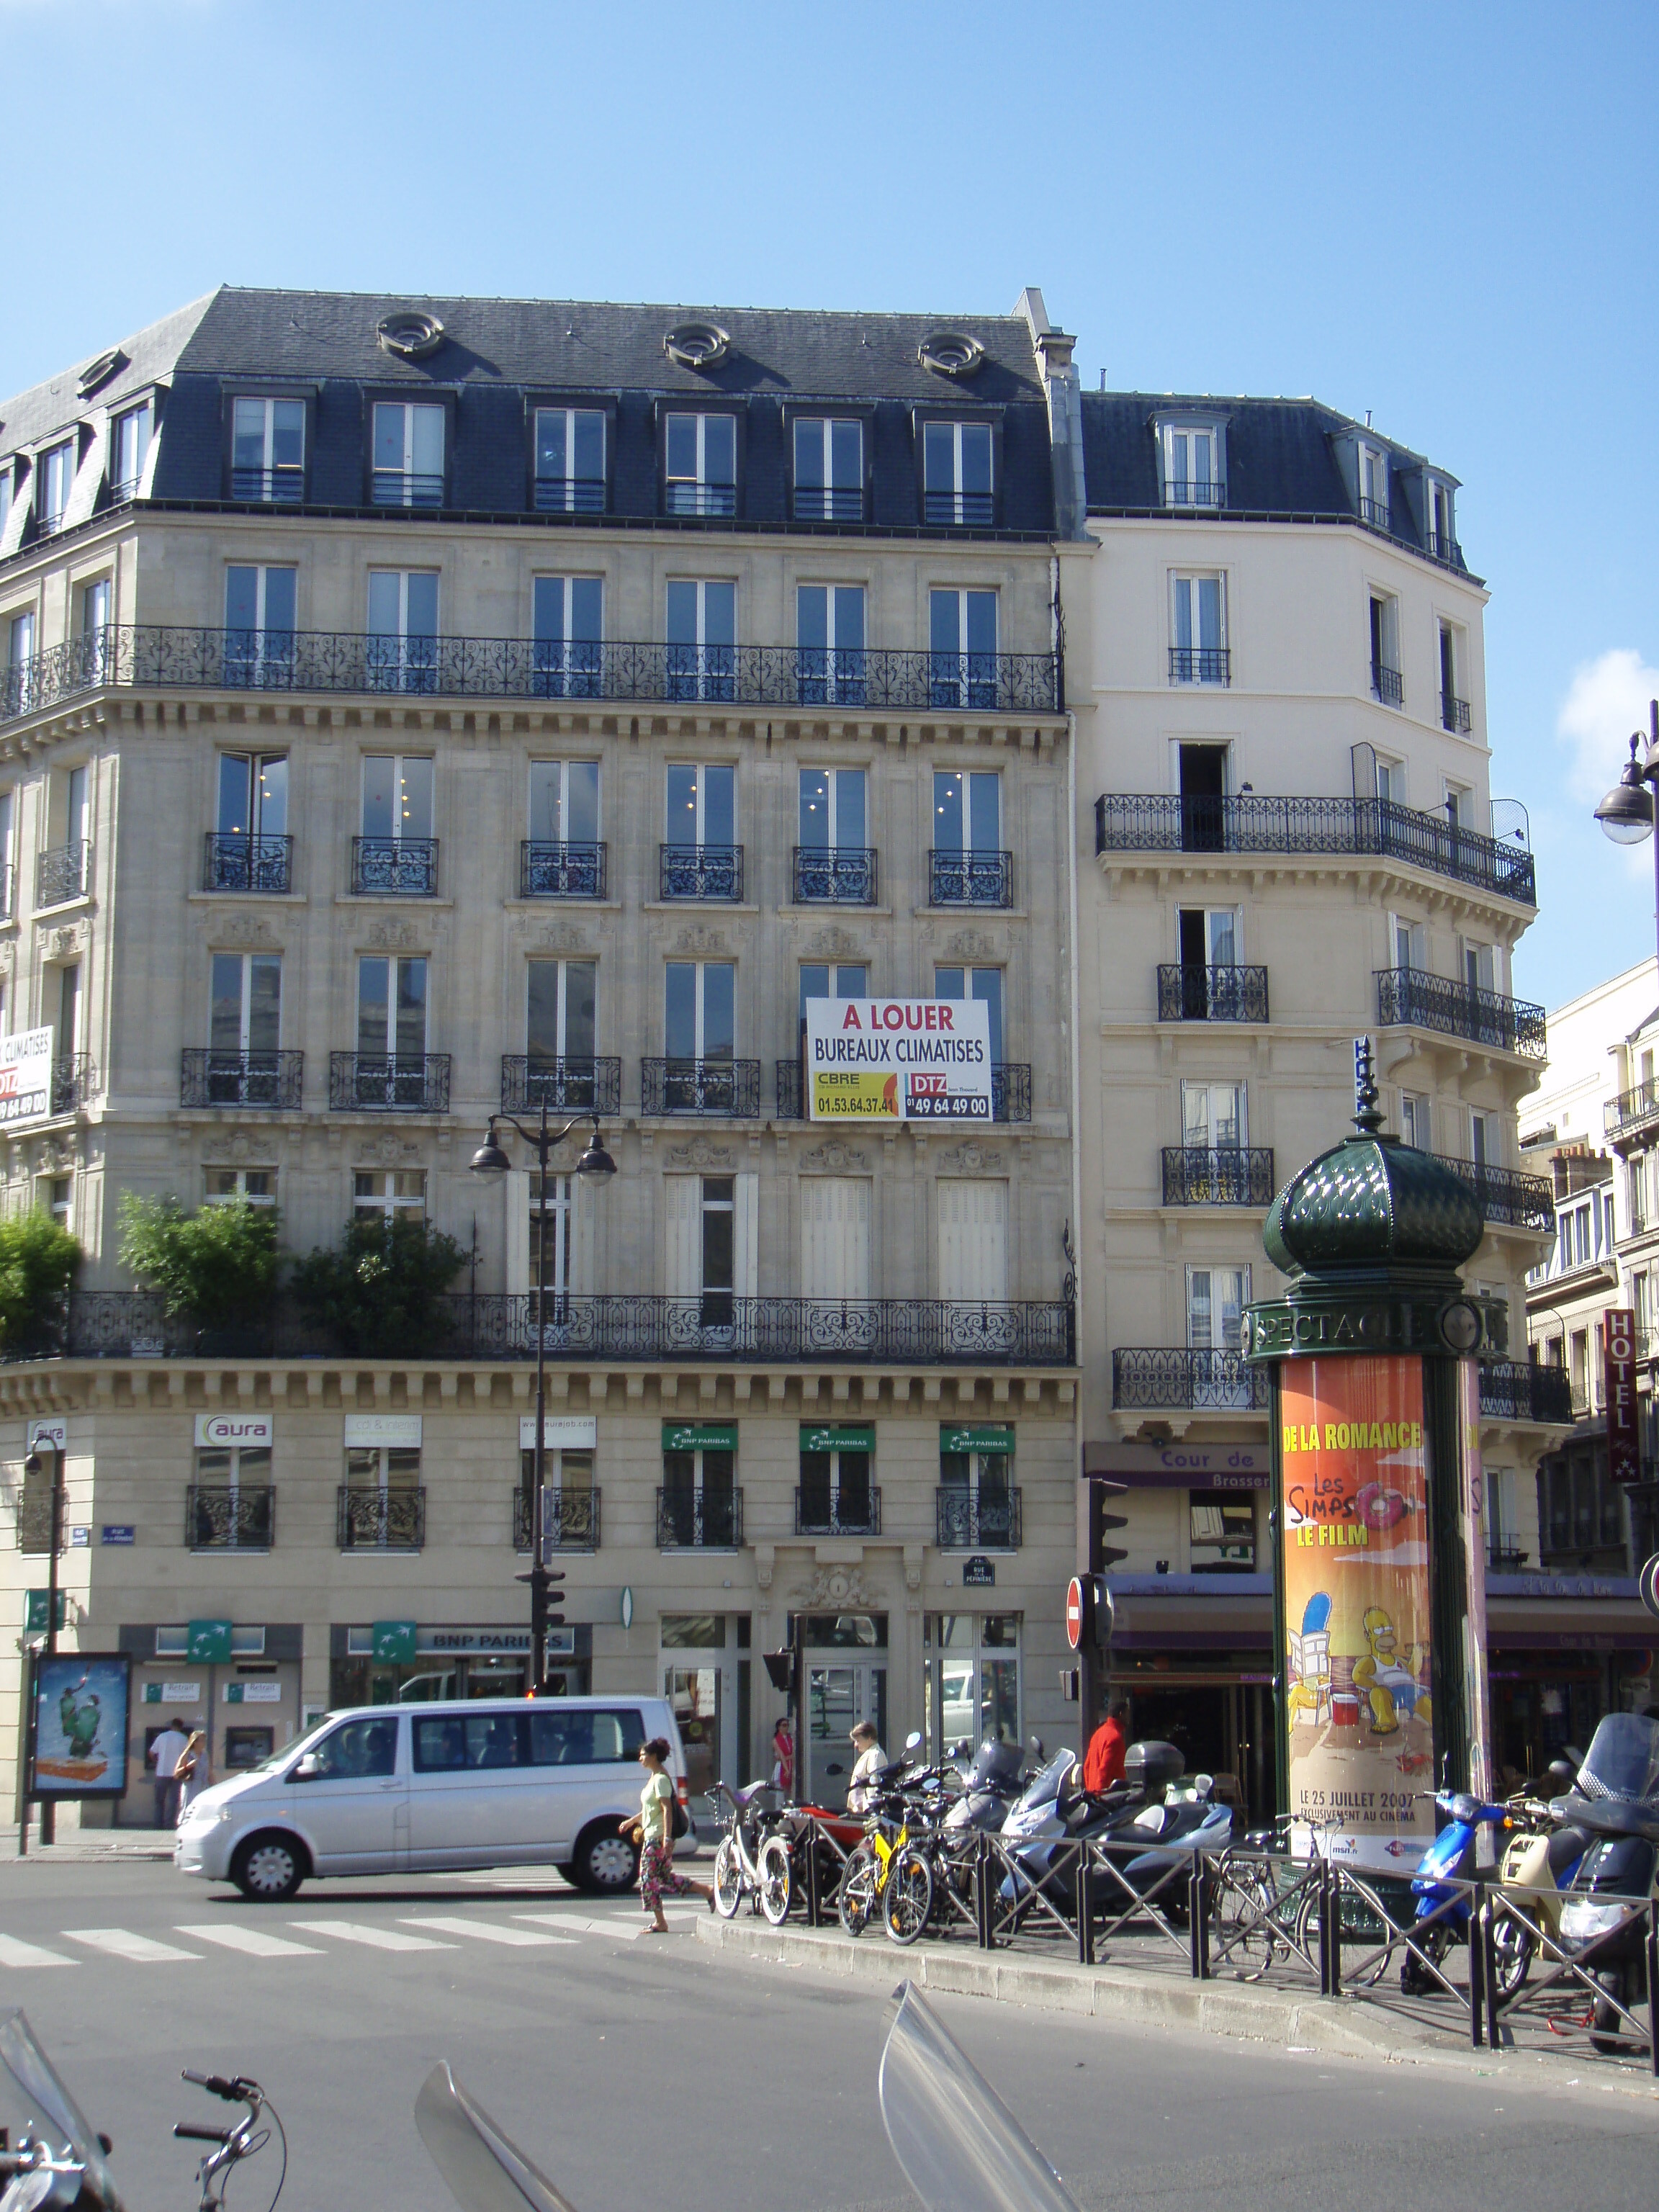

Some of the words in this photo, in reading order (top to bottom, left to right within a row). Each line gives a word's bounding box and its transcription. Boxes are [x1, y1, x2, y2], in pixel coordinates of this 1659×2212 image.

[842, 1004, 862, 1030] A
[871, 1004, 955, 1030] LOUER
[6, 1032, 48, 1062] CLIMATISES
[815, 1038, 891, 1062] BUREAUX
[896, 1038, 984, 1063] CLIMATISES
[818, 1073, 860, 1084] CBRE
[914, 1076, 947, 1092] DTZ
[8, 1098, 19, 1118] 64
[34, 1092, 46, 1112] 00
[819, 1097, 893, 1112] 01.53.64.37.41
[915, 1098, 930, 1113] 49
[934, 1098, 949, 1114] 64
[953, 1098, 968, 1113] 49
[971, 1098, 986, 1114] 00
[1610, 1315, 1630, 1428] HOTEL
[216, 1423, 266, 1437] aura
[1284, 1425, 1297, 1452] DE
[1300, 1424, 1321, 1451] LA
[1325, 1422, 1421, 1449] ROMANCE
[1161, 1452, 1210, 1467] Cour
[1228, 1452, 1254, 1467] de
[1314, 1473, 1344, 1496] Les
[1298, 1525, 1314, 1547] LE
[1318, 1525, 1368, 1547] FILM
[433, 1635, 473, 1647] BNP
[1300, 1789, 1309, 1804] LE
[1312, 1791, 1325, 1805] 25
[1329, 1791, 1375, 1807] JUILLET
[1380, 1793, 1414, 1808] 2007
[1300, 1807, 1360, 1821] EXCLUSIVEMENT
[1363, 1811, 1376, 1821] AU
